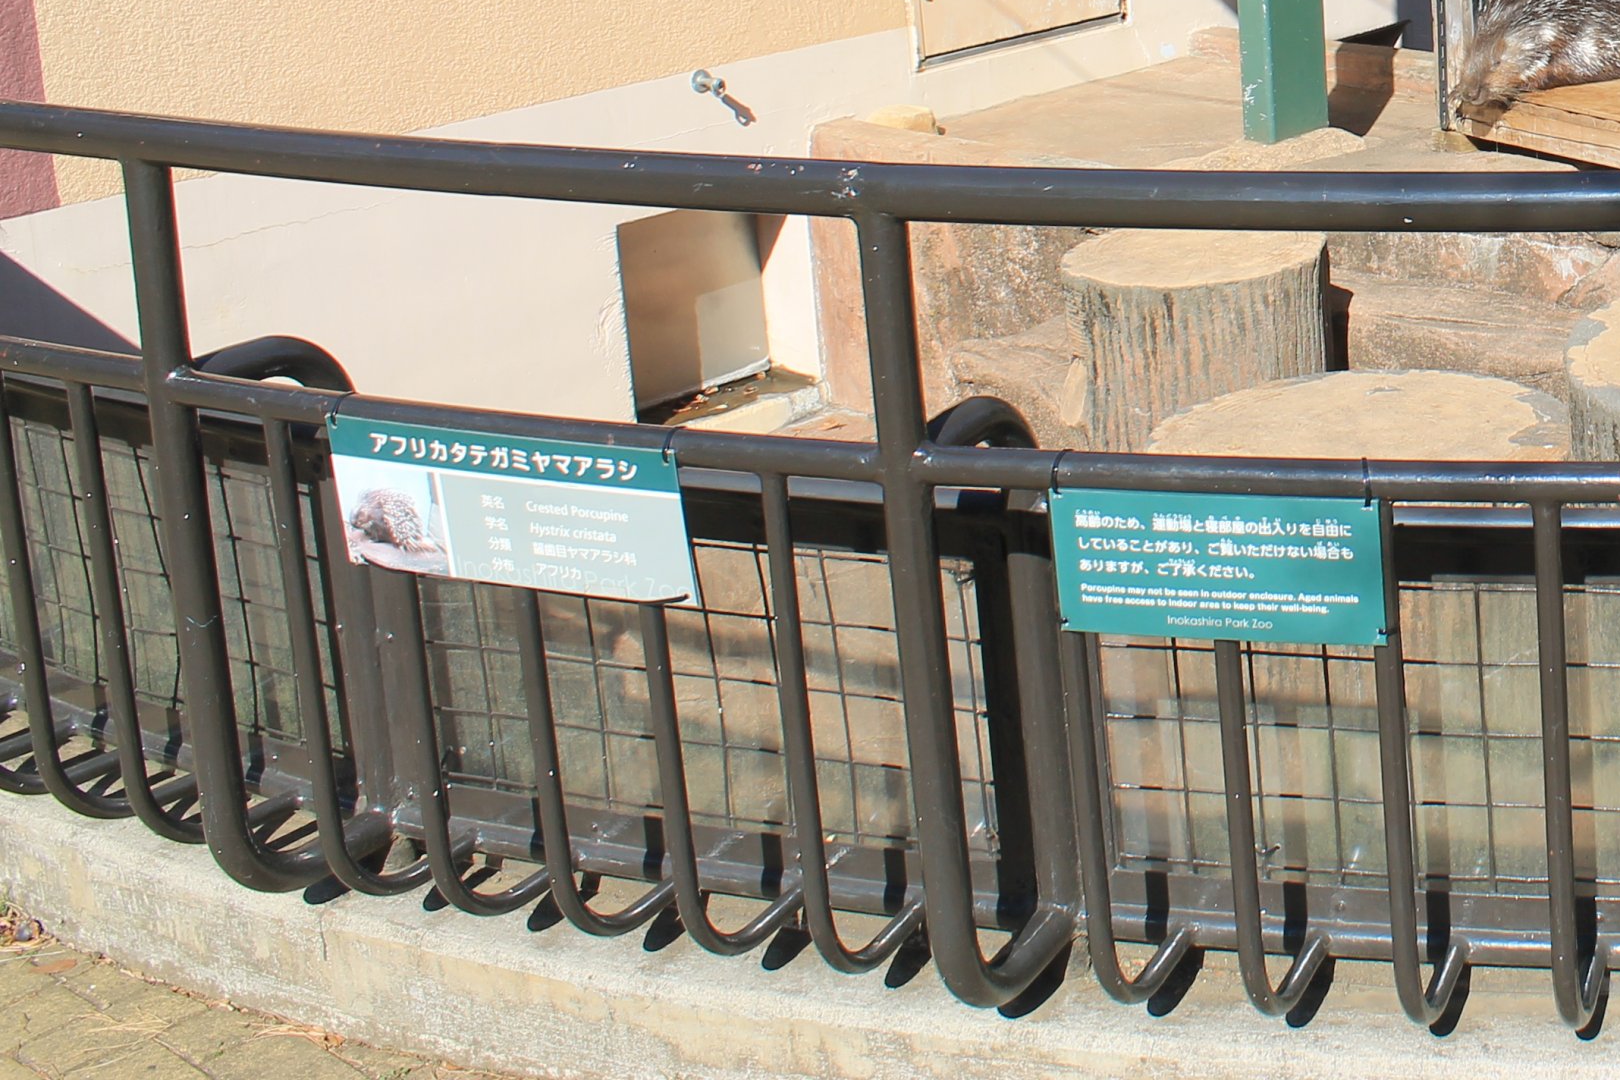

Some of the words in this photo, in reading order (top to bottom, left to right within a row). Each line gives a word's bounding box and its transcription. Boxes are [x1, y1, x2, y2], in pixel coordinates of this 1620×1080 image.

[369, 432, 639, 481] アフリカタテガミヤマアラシ
[481, 494, 505, 510] 英名
[526, 500, 568, 517] Crested
[570, 505, 629, 523] Porcupine
[484, 516, 508, 531] 学名
[530, 522, 570, 539] Hystrix
[573, 527, 617, 543] cristata
[488, 536, 512, 552] 分類
[492, 557, 514, 572] 分布
[535, 563, 582, 580] アフリカ
[1080, 583, 1126, 594] Porcupine
[1127, 587, 1146, 596] may
[1148, 586, 1163, 596] not
[1165, 586, 1176, 596] be
[1177, 589, 1199, 597] seen
[1200, 588, 1210, 598] in
[1211, 590, 1247, 600] outdoor
[1249, 591, 1296, 601] enclosure.
[1298, 592, 1322, 603] Aged
[1324, 594, 1359, 604] animals
[1082, 594, 1103, 604] have
[1105, 595, 1124, 604] free
[1125, 597, 1155, 606] access
[1157, 597, 1167, 606] to
[1168, 598, 1198, 608] indoor
[1199, 600, 1220, 609] area
[1222, 601, 1231, 610] to
[1233, 601, 1255, 612] keep
[1257, 602, 1279, 611] their
[1280, 604, 1330, 614] well-being.
[1167, 615, 1222, 627] Inokashira
[1225, 617, 1249, 628] Park
[1252, 618, 1273, 630] Zoo
